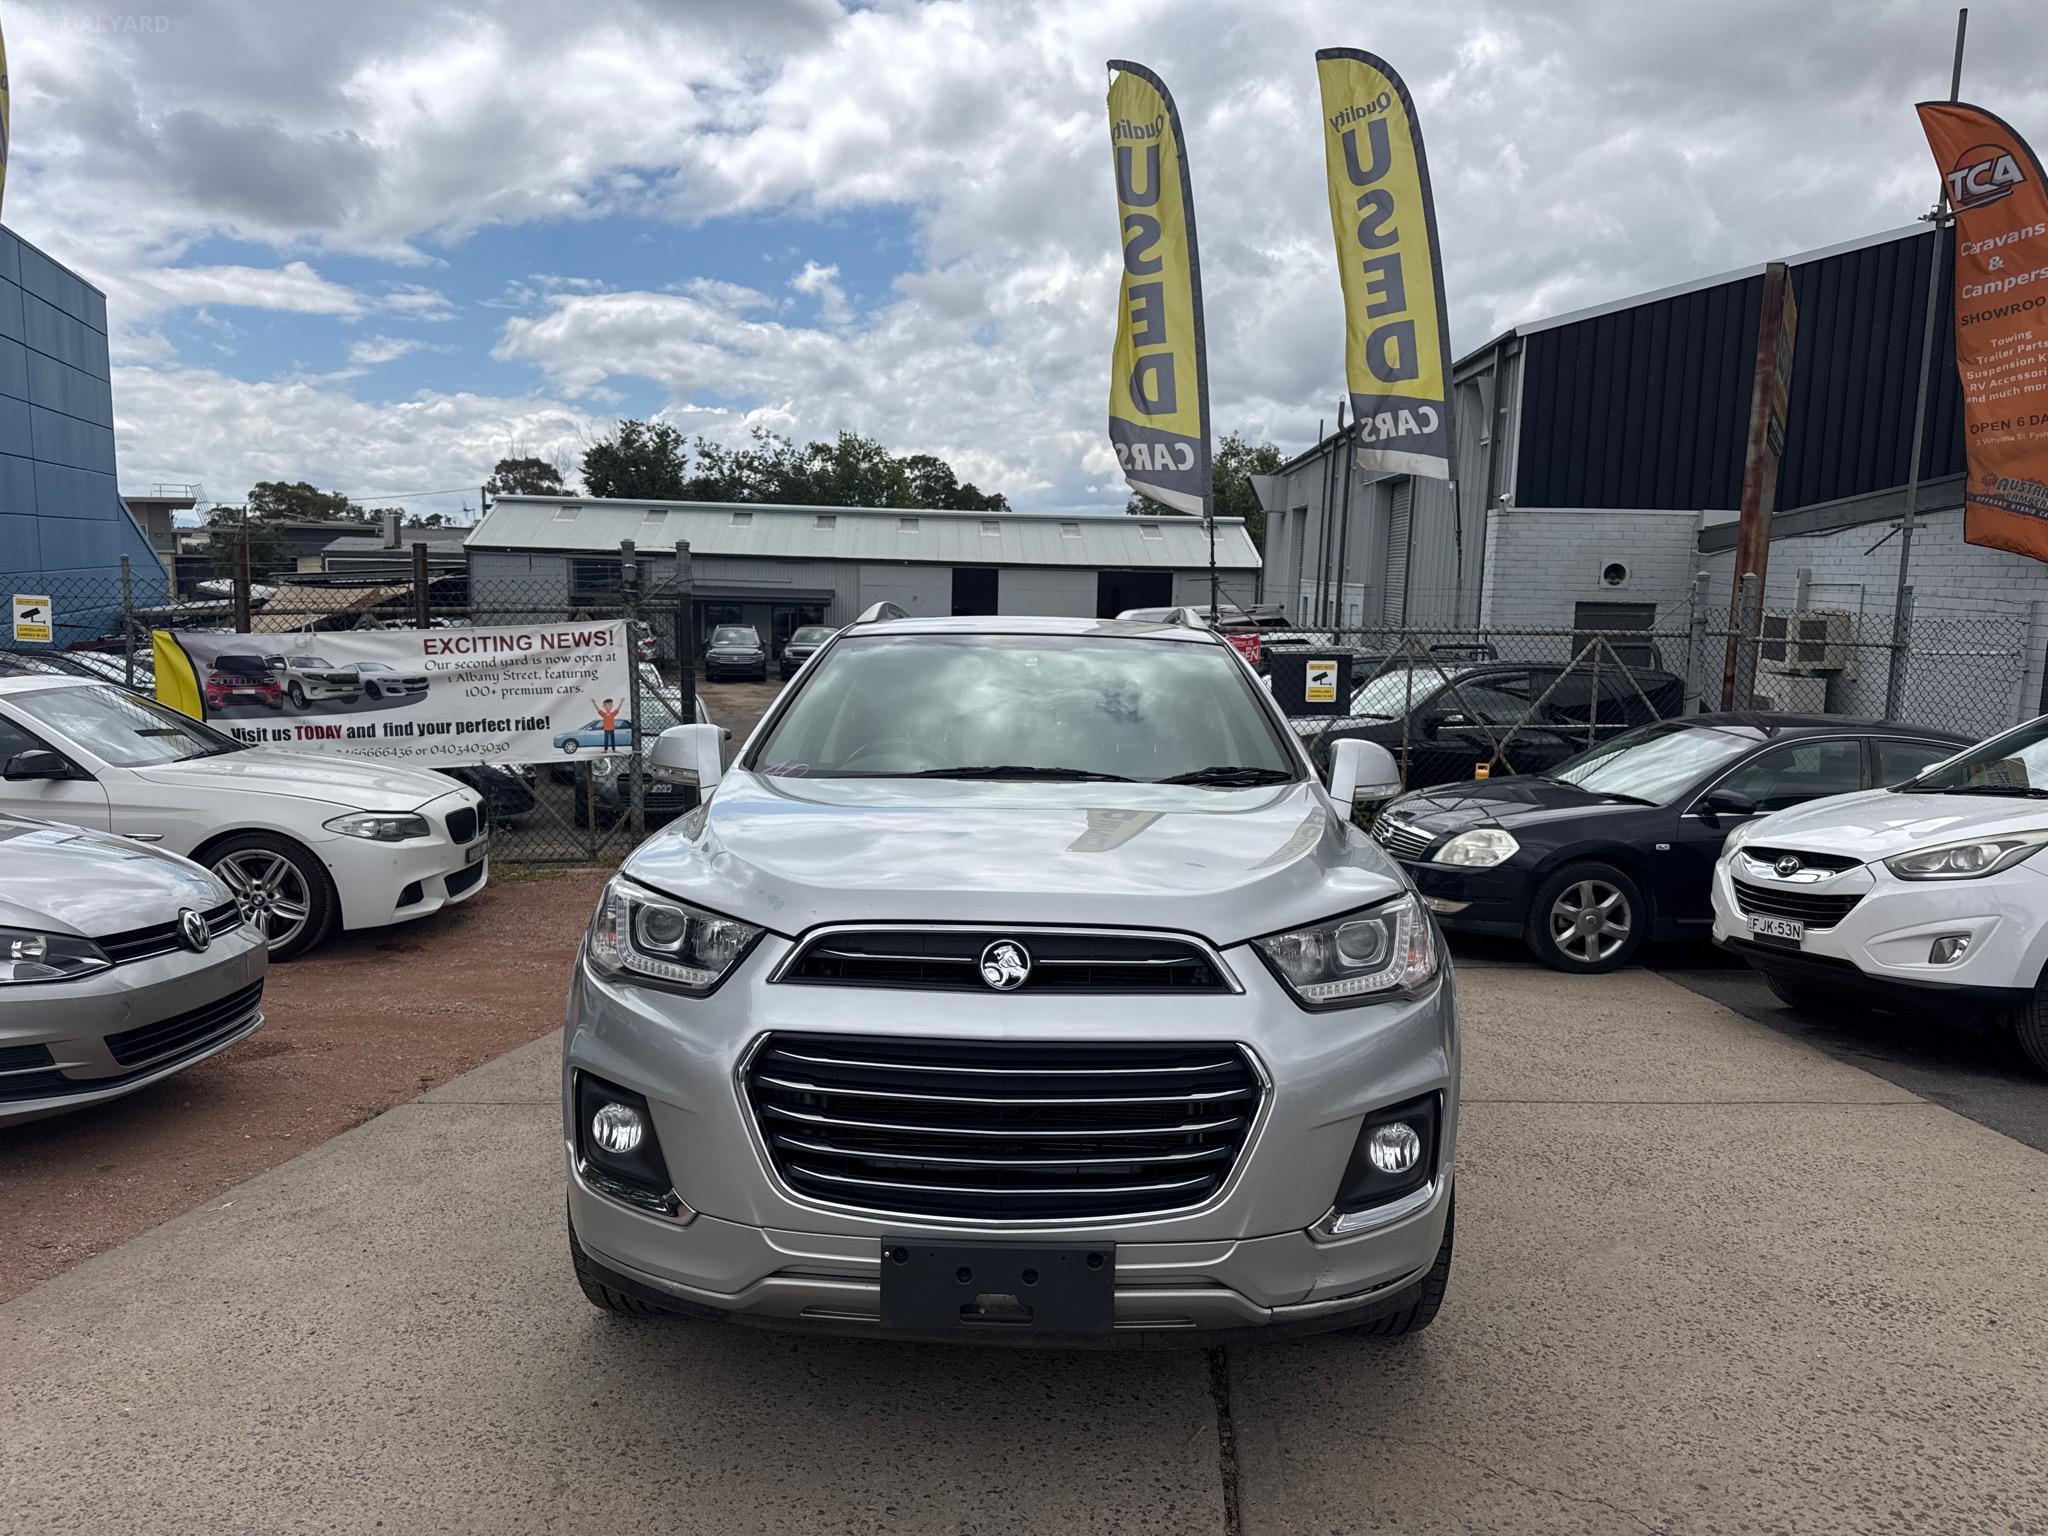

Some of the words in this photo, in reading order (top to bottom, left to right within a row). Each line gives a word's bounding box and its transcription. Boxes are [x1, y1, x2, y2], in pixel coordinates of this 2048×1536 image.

[1947, 155, 2025, 201] TCA
[1960, 222, 2046, 257] Caravans
[1988, 255, 2005, 271] &
[1962, 266, 2048, 299] Campers
[1960, 295, 2047, 326] SHOWROO
[1990, 330, 2033, 348] Towing
[1976, 348, 2015, 365] Trailer
[2017, 340, 2048, 353] Parts
[1966, 356, 2035, 380] Suspension
[1970, 381, 1986, 392] RV
[1989, 367, 2047, 389] Accessori
[1966, 394, 1986, 403] and
[1989, 386, 2021, 401] much
[2024, 383, 2048, 393] mor
[1970, 419, 2011, 435] OPEN
[2017, 416, 2025, 427] 6
[2030, 414, 2048, 426] DA
[1996, 477, 2048, 498] AUSTRA
[423, 634, 533, 655] EXCITING
[540, 630, 614, 650] NEWS!
[424, 659, 450, 671] Our
[454, 654, 497, 670] second
[500, 653, 529, 671] yard
[532, 652, 542, 665] is
[545, 654, 571, 665] now
[574, 652, 603, 667] open
[606, 651, 617, 662] at
[456, 671, 500, 684] Albany
[545, 666, 600, 681] featuring
[464, 686, 496, 698] 100+
[501, 683, 551, 699] premium
[555, 683, 584, 695] cars.
[231, 727, 268, 742] Visit
[272, 728, 292, 741] us
[294, 725, 343, 741] TODAY
[347, 723, 376, 739] and
[383, 721, 414, 737] find
[417, 722, 451, 737] your
[456, 718, 512, 735] perfect
[514, 716, 551, 731] ride!
[336, 747, 413, 758] 66666436
[415, 747, 428, 756] or
[430, 742, 510, 758] 0403403030
